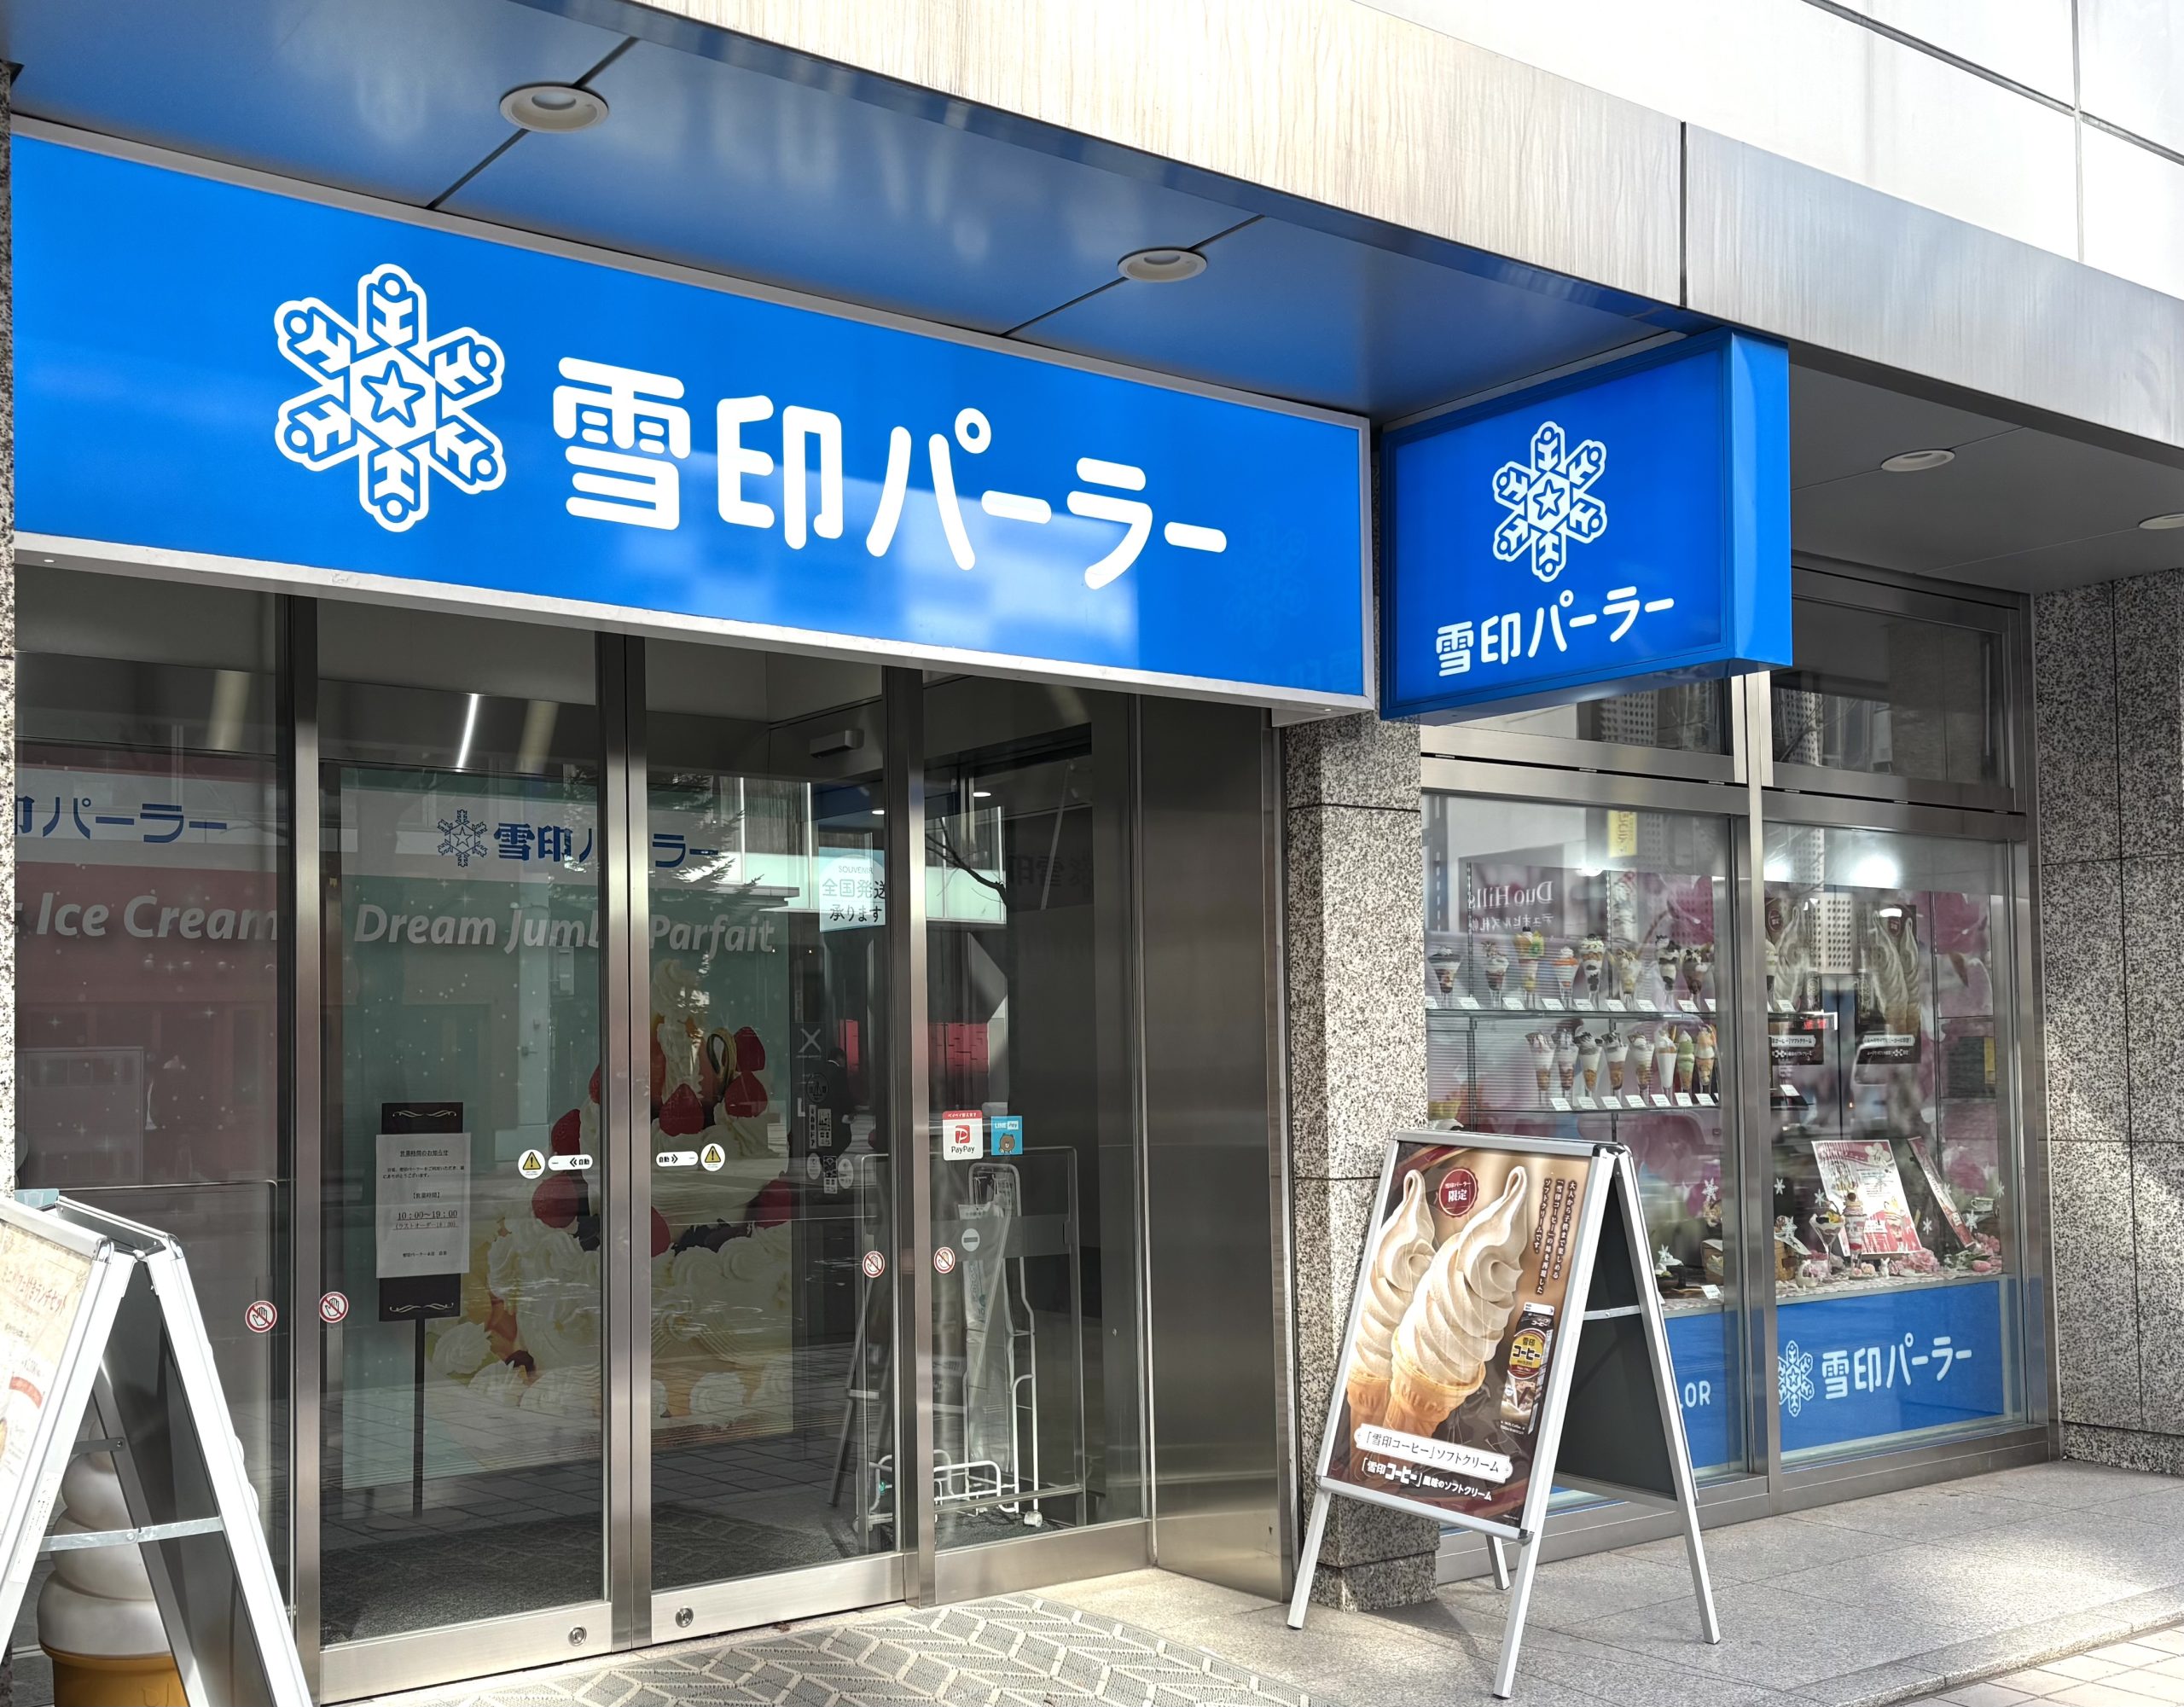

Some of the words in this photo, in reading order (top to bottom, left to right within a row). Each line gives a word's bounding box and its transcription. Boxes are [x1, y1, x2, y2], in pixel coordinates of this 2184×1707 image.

[553, 357, 1227, 589] 雪印パーラー
[1436, 585, 1675, 676] 雪印パーラー
[838, 865, 874, 874] SOUVENIR
[822, 878, 886, 899] 全国発送
[36, 892, 109, 937] Ice
[829, 904, 882, 922] 承ります
[354, 903, 496, 945] Dream
[649, 914, 775, 961] Parfait
[951, 1146, 975, 1154] PayPay
[1448, 1189, 1468, 1203] 限定
[1512, 1344, 1541, 1361] コーヒー
[1522, 1337, 1536, 1347] 雪印
[1822, 1332, 1972, 1400] 雪印パーラー
[1366, 1431, 1499, 1472] 「雪印コーヒー」ソフトクリーム
